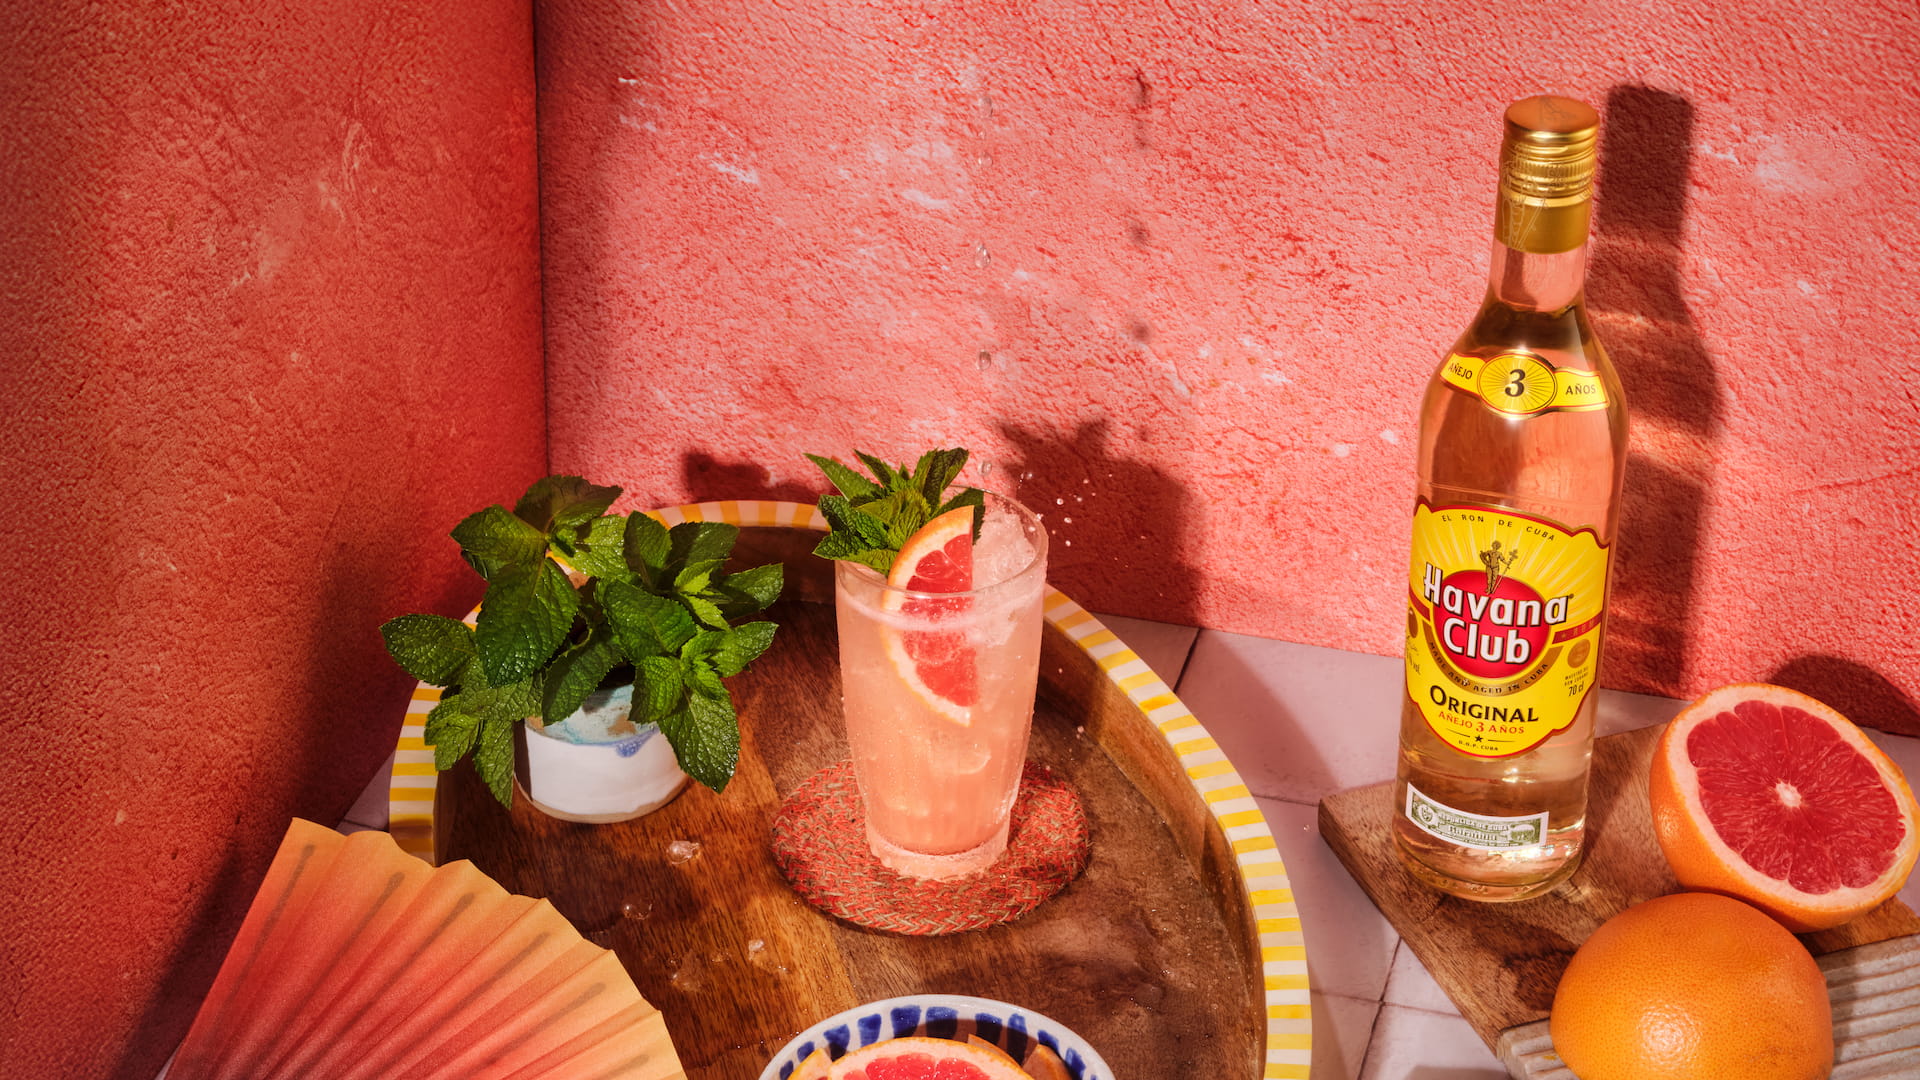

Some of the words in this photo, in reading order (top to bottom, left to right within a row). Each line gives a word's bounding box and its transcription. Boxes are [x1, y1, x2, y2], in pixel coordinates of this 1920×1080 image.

[1448, 362, 1473, 380] AÑEJO
[1504, 368, 1526, 397] 3
[1565, 383, 1596, 396] AÑOS
[1442, 514, 1452, 522] EL
[1461, 513, 1484, 522] RON
[1498, 519, 1513, 528] DE
[1526, 526, 1555, 541] CUBA
[1423, 562, 1568, 627] Havana
[1442, 617, 1531, 665] Club
[1473, 685, 1502, 694] AGED
[1507, 683, 1520, 692] IN
[1524, 663, 1548, 684] CUBA
[1568, 685, 1578, 697] 70
[1578, 681, 1585, 693] cl
[1430, 685, 1539, 723] ORIGINAL
[1438, 711, 1473, 729] AÑEJO
[1475, 721, 1485, 733] 3
[1488, 724, 1525, 734] AÑOS
